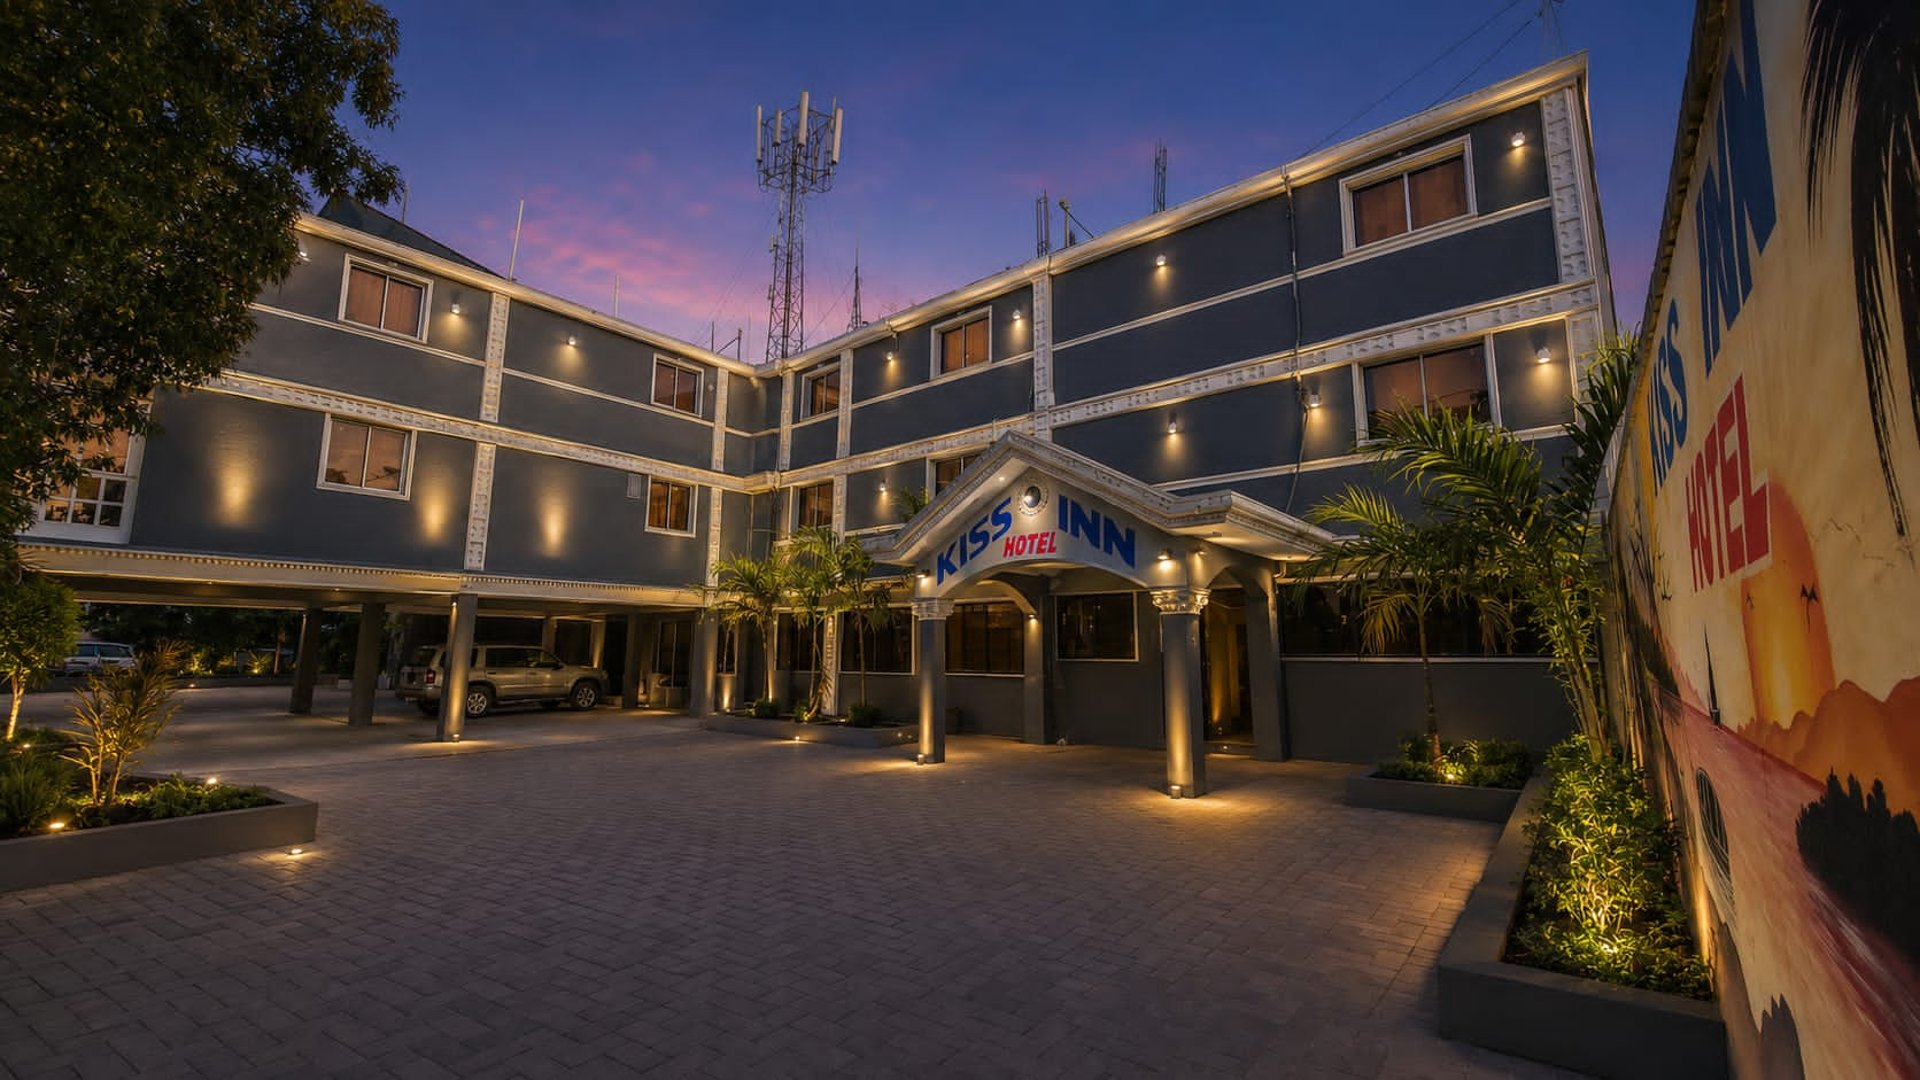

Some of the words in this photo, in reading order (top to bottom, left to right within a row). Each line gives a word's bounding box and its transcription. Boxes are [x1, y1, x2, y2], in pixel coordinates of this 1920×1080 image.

[1648, 298, 1687, 496] KISS
[1697, 0, 1776, 378] INN
[937, 496, 1013, 585] KISS
[1058, 494, 1135, 568] INN
[1003, 531, 1057, 557] HOTEL
[1686, 374, 1770, 593] HOTEL
